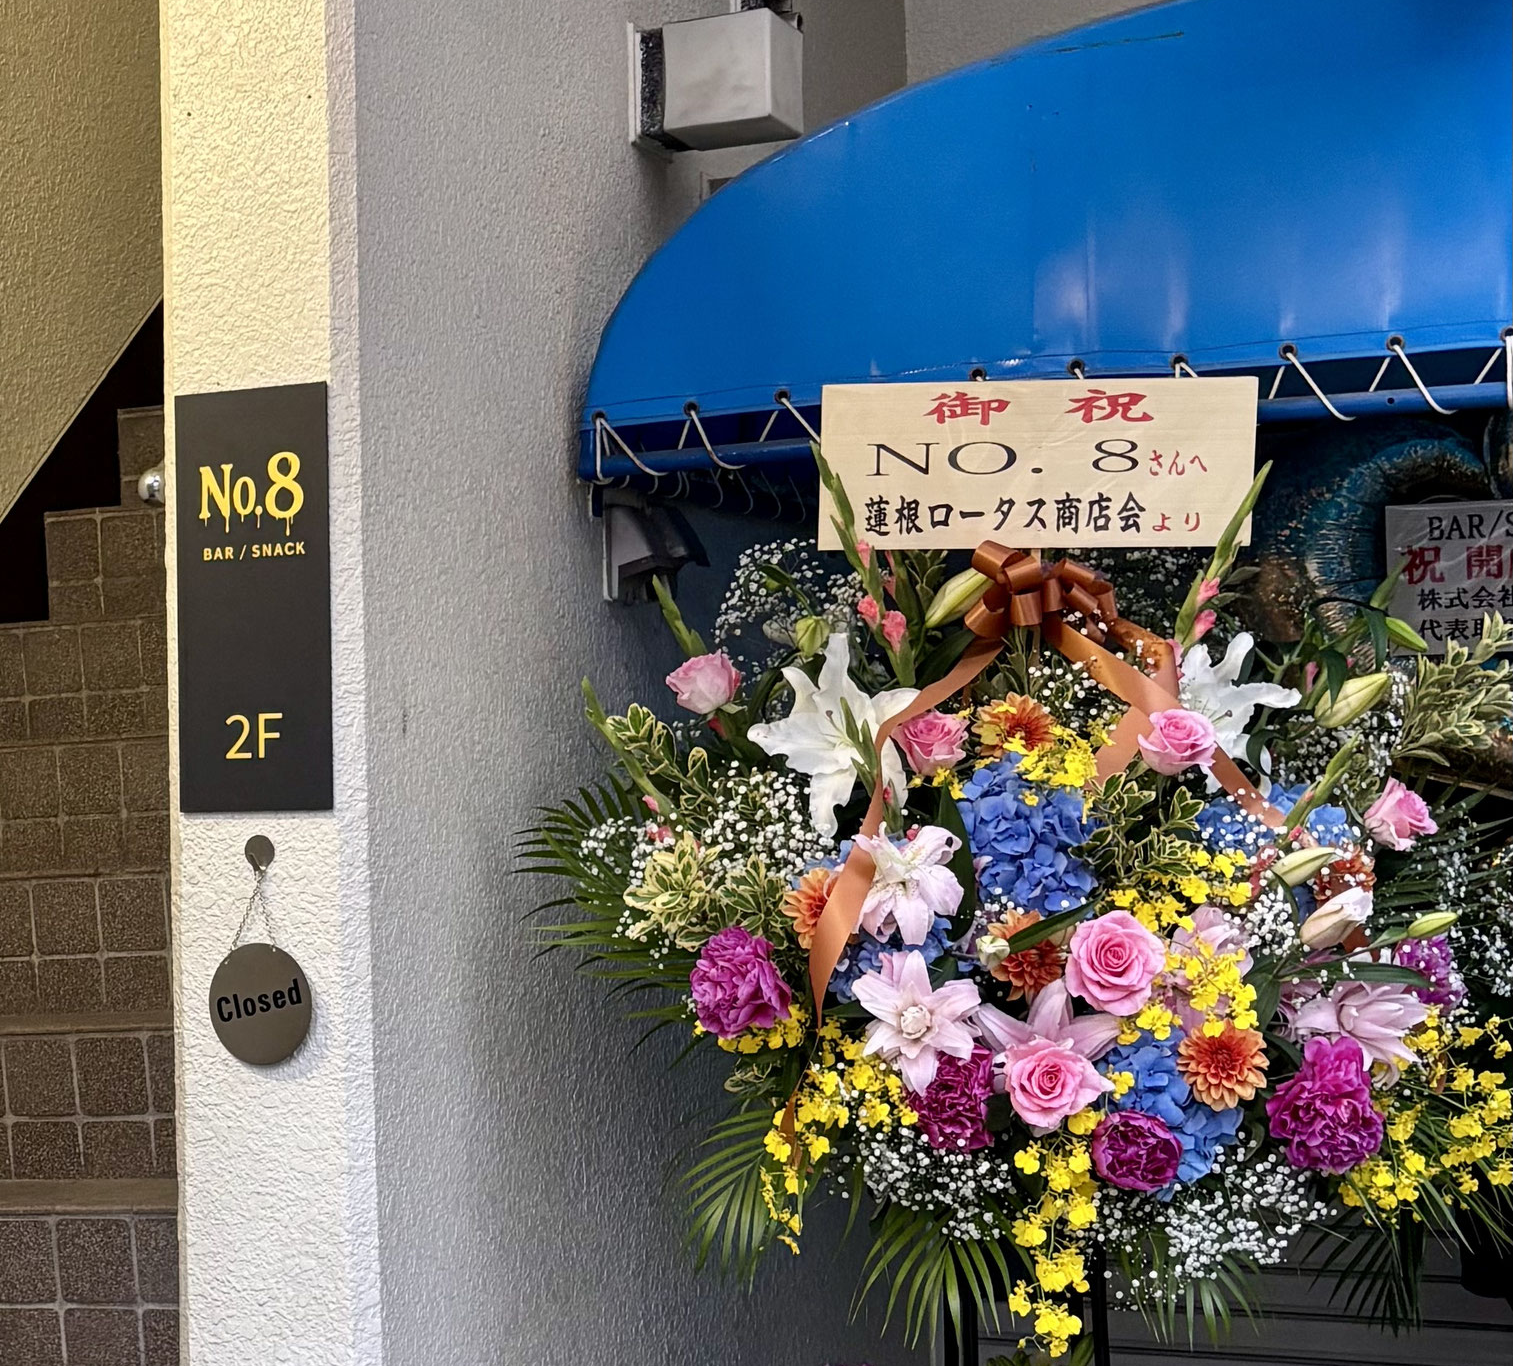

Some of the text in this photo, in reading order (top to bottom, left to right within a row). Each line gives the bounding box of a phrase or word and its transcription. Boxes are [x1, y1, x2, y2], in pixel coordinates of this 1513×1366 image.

[198, 451, 304, 536] No.8
[203, 546, 234, 561] BAR
[251, 541, 306, 558] SNACK
[224, 712, 284, 760] 2F
[216, 979, 303, 1023] Closed
